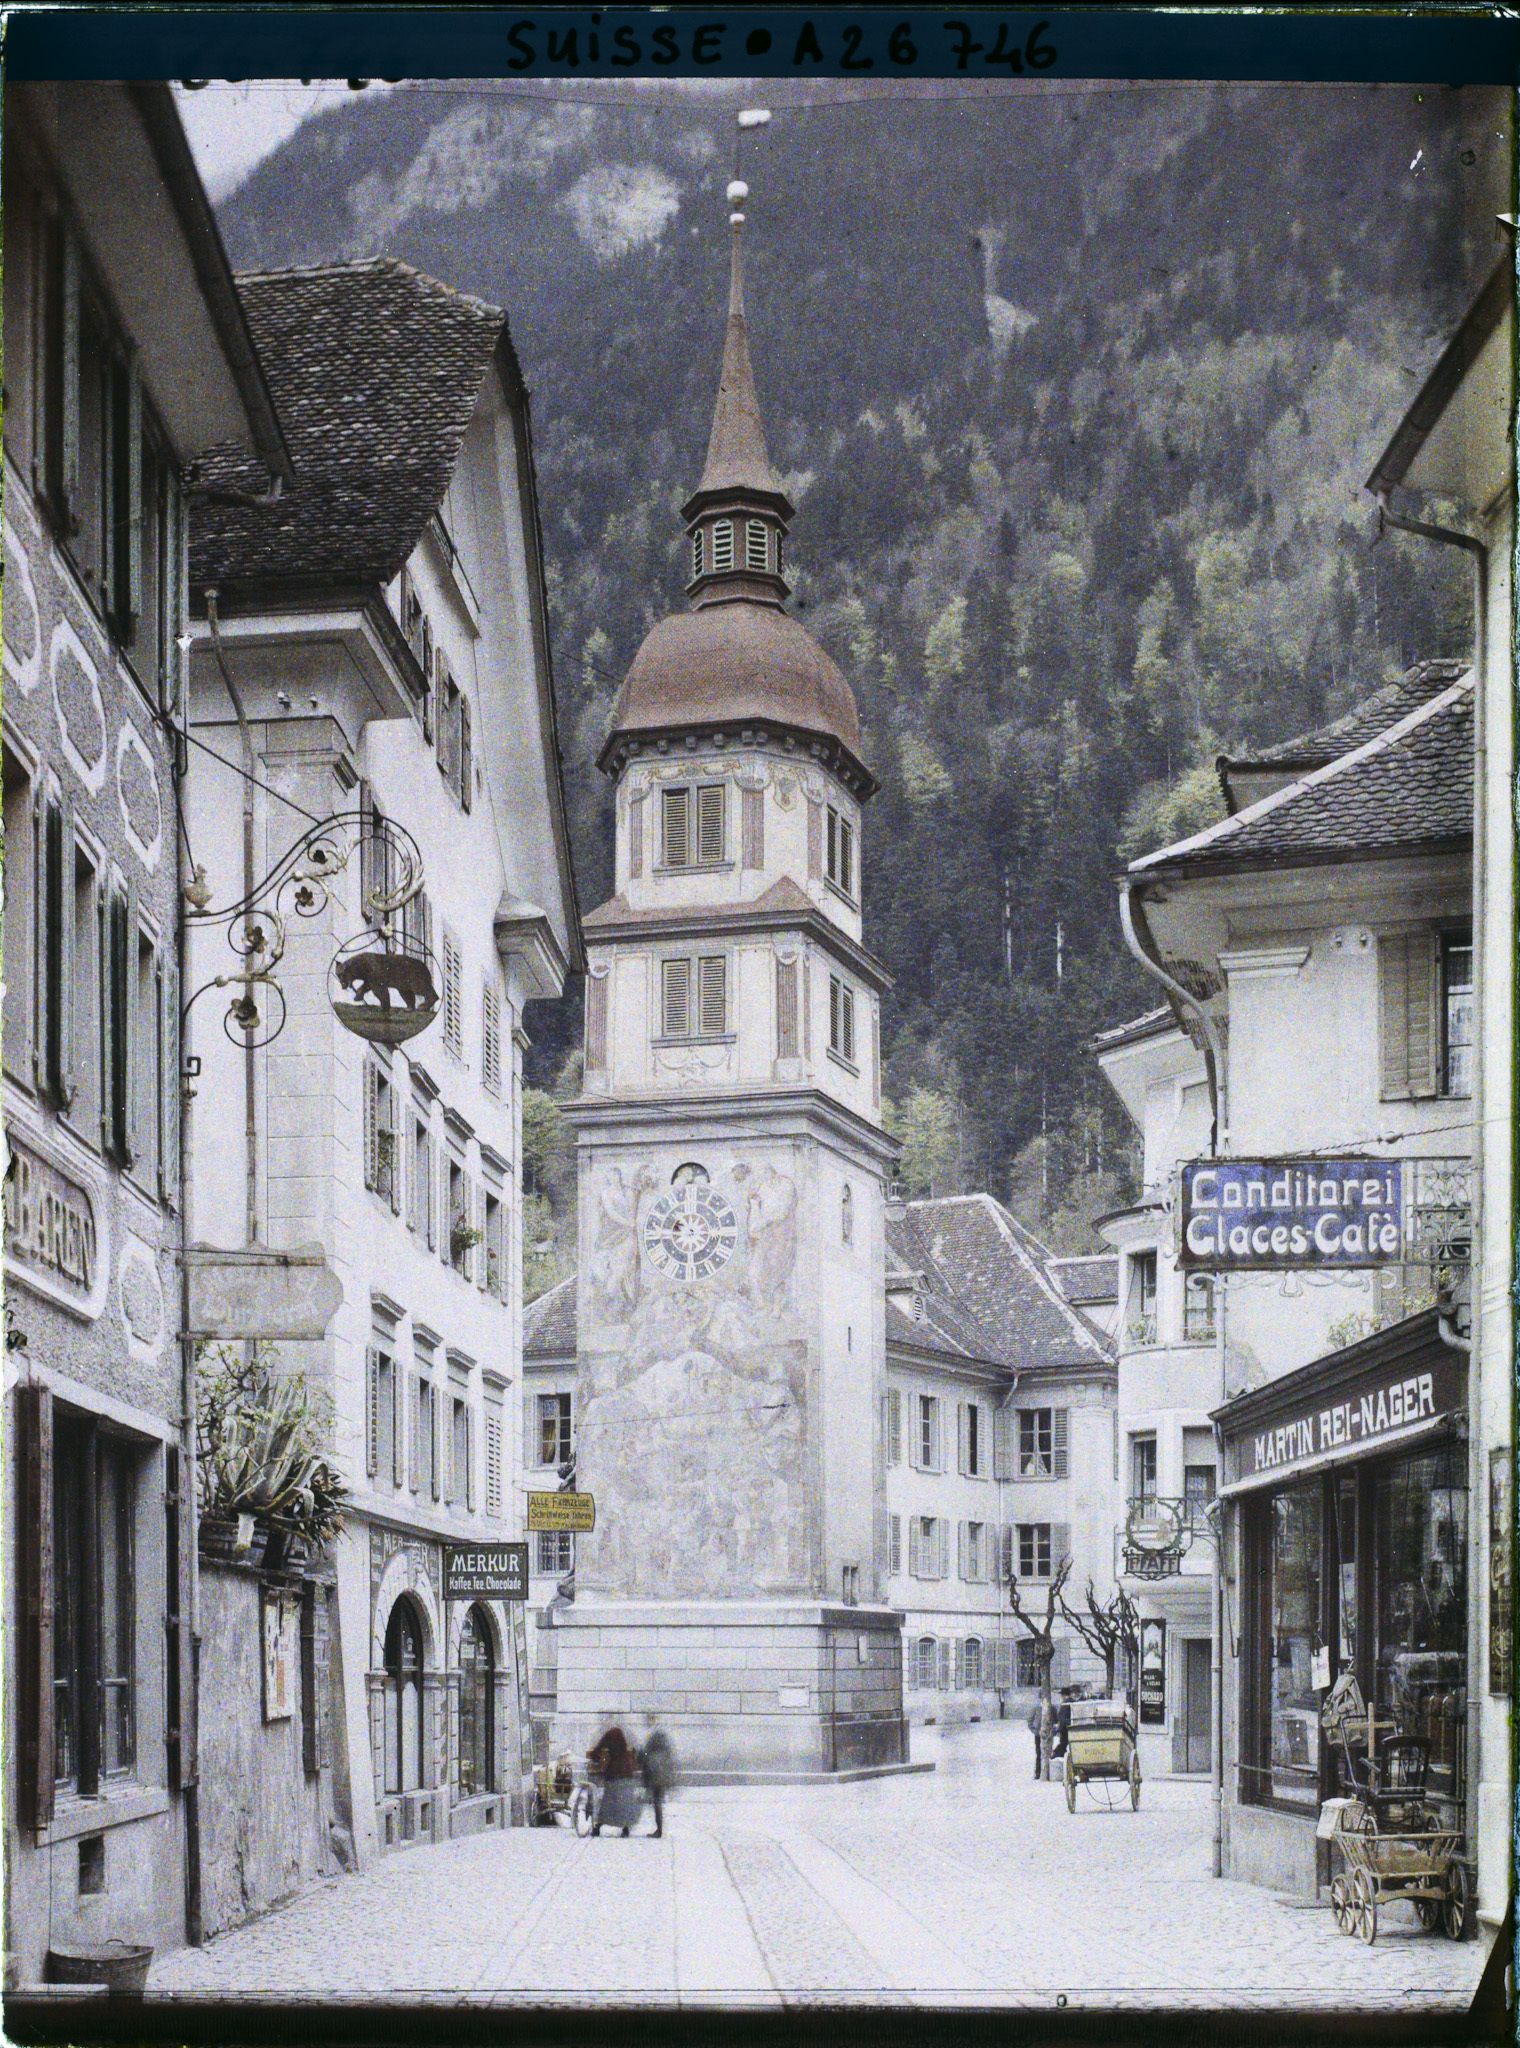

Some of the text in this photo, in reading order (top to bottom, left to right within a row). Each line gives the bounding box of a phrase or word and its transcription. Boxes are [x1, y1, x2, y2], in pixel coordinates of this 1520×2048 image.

[1190, 1169, 1394, 1209] Conditorei
[1254, 1373, 1436, 1470] MARTIN REI-NAGER
[451, 1554, 520, 1572] MERKUR
